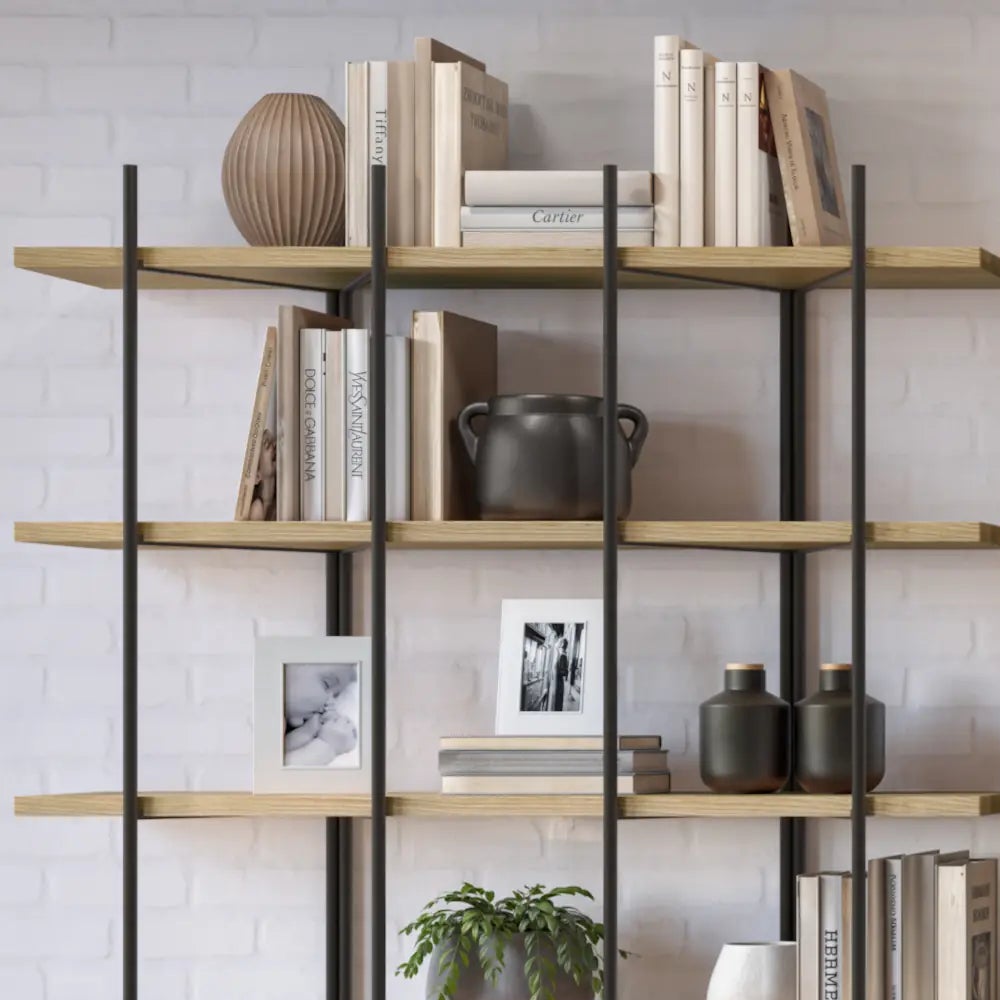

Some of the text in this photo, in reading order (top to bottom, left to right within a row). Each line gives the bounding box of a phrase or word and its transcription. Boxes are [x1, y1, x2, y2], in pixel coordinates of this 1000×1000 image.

[372, 109, 387, 163] Tiffany
[532, 209, 584, 223] Cartier
[305, 369, 316, 408] DOLCE
[305, 417, 316, 481] GABBANA
